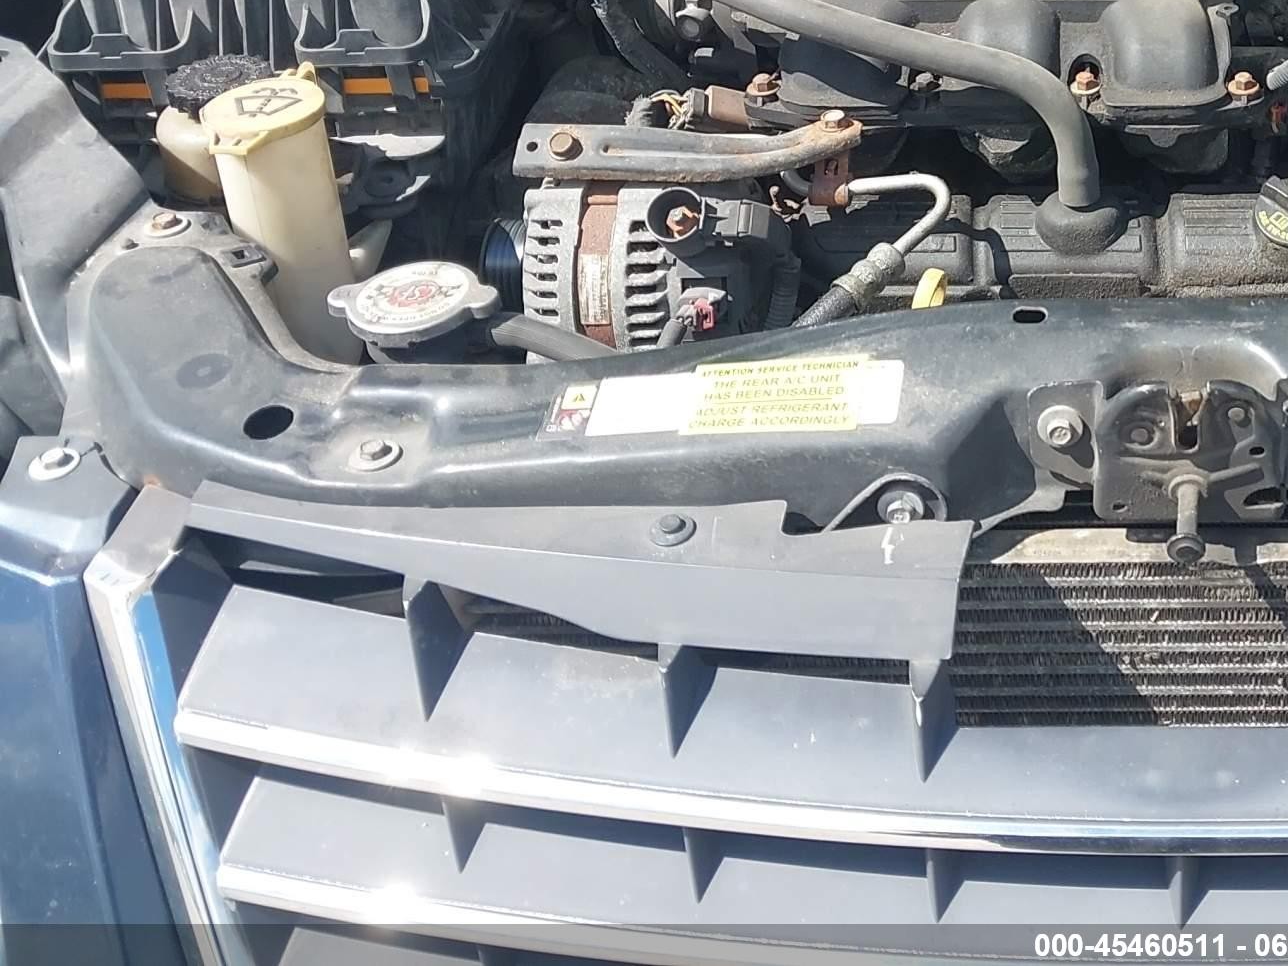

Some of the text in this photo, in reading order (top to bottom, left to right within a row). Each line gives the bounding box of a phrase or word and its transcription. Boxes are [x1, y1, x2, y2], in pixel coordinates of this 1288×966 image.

[702, 361, 859, 377] ATTENTION SERVICE TECHNICIAN
[713, 374, 841, 389] THE REAR A/C UNIT
[704, 386, 845, 402] HAS BEEN DISABLED
[696, 402, 849, 417] ADJUST REFRIGERANT
[688, 415, 850, 429] CHARGE ACCORDINGLY
